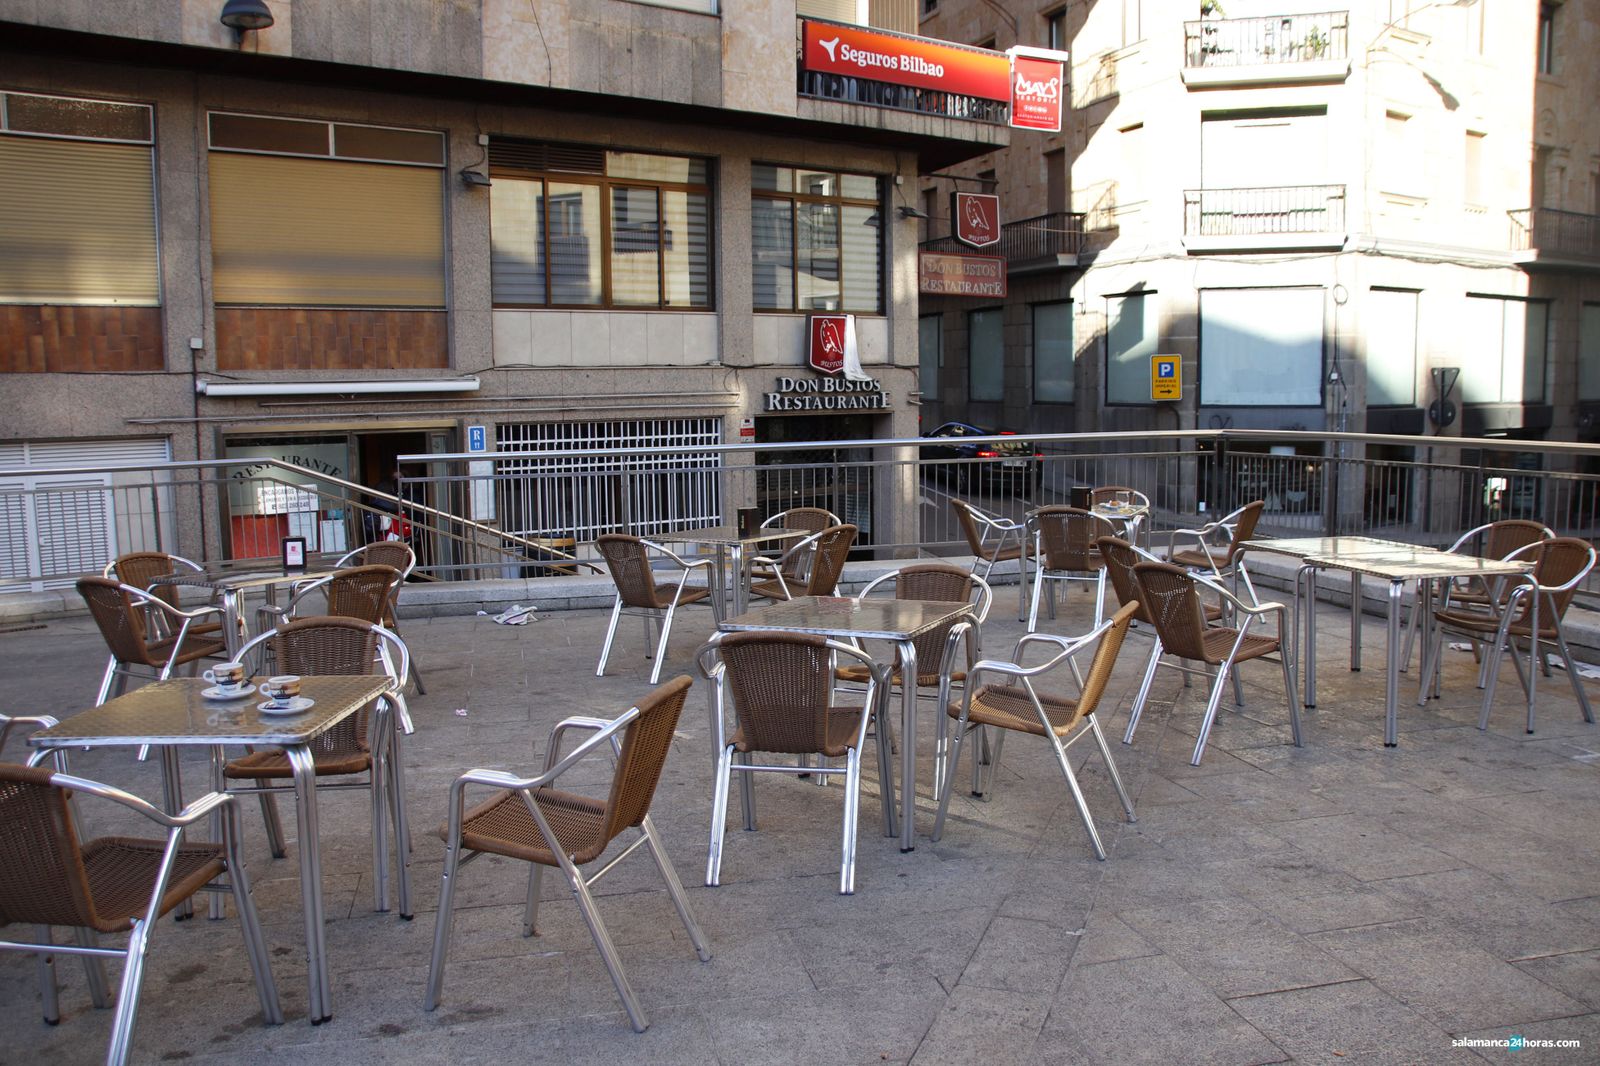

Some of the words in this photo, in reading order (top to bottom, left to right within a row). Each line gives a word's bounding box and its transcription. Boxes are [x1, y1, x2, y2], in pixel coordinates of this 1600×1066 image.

[841, 44, 898, 69] Seguros
[900, 55, 944, 78] Bilbao
[927, 259, 953, 274] DON
[920, 276, 1003, 295] RESTAURANTE
[1161, 363, 1171, 377] P
[781, 377, 818, 393] DON
[823, 377, 880, 392] BUSTOS
[768, 391, 891, 410] RESTAURANTE
[473, 429, 481, 441] R
[232, 455, 342, 484] RESTURANTE
